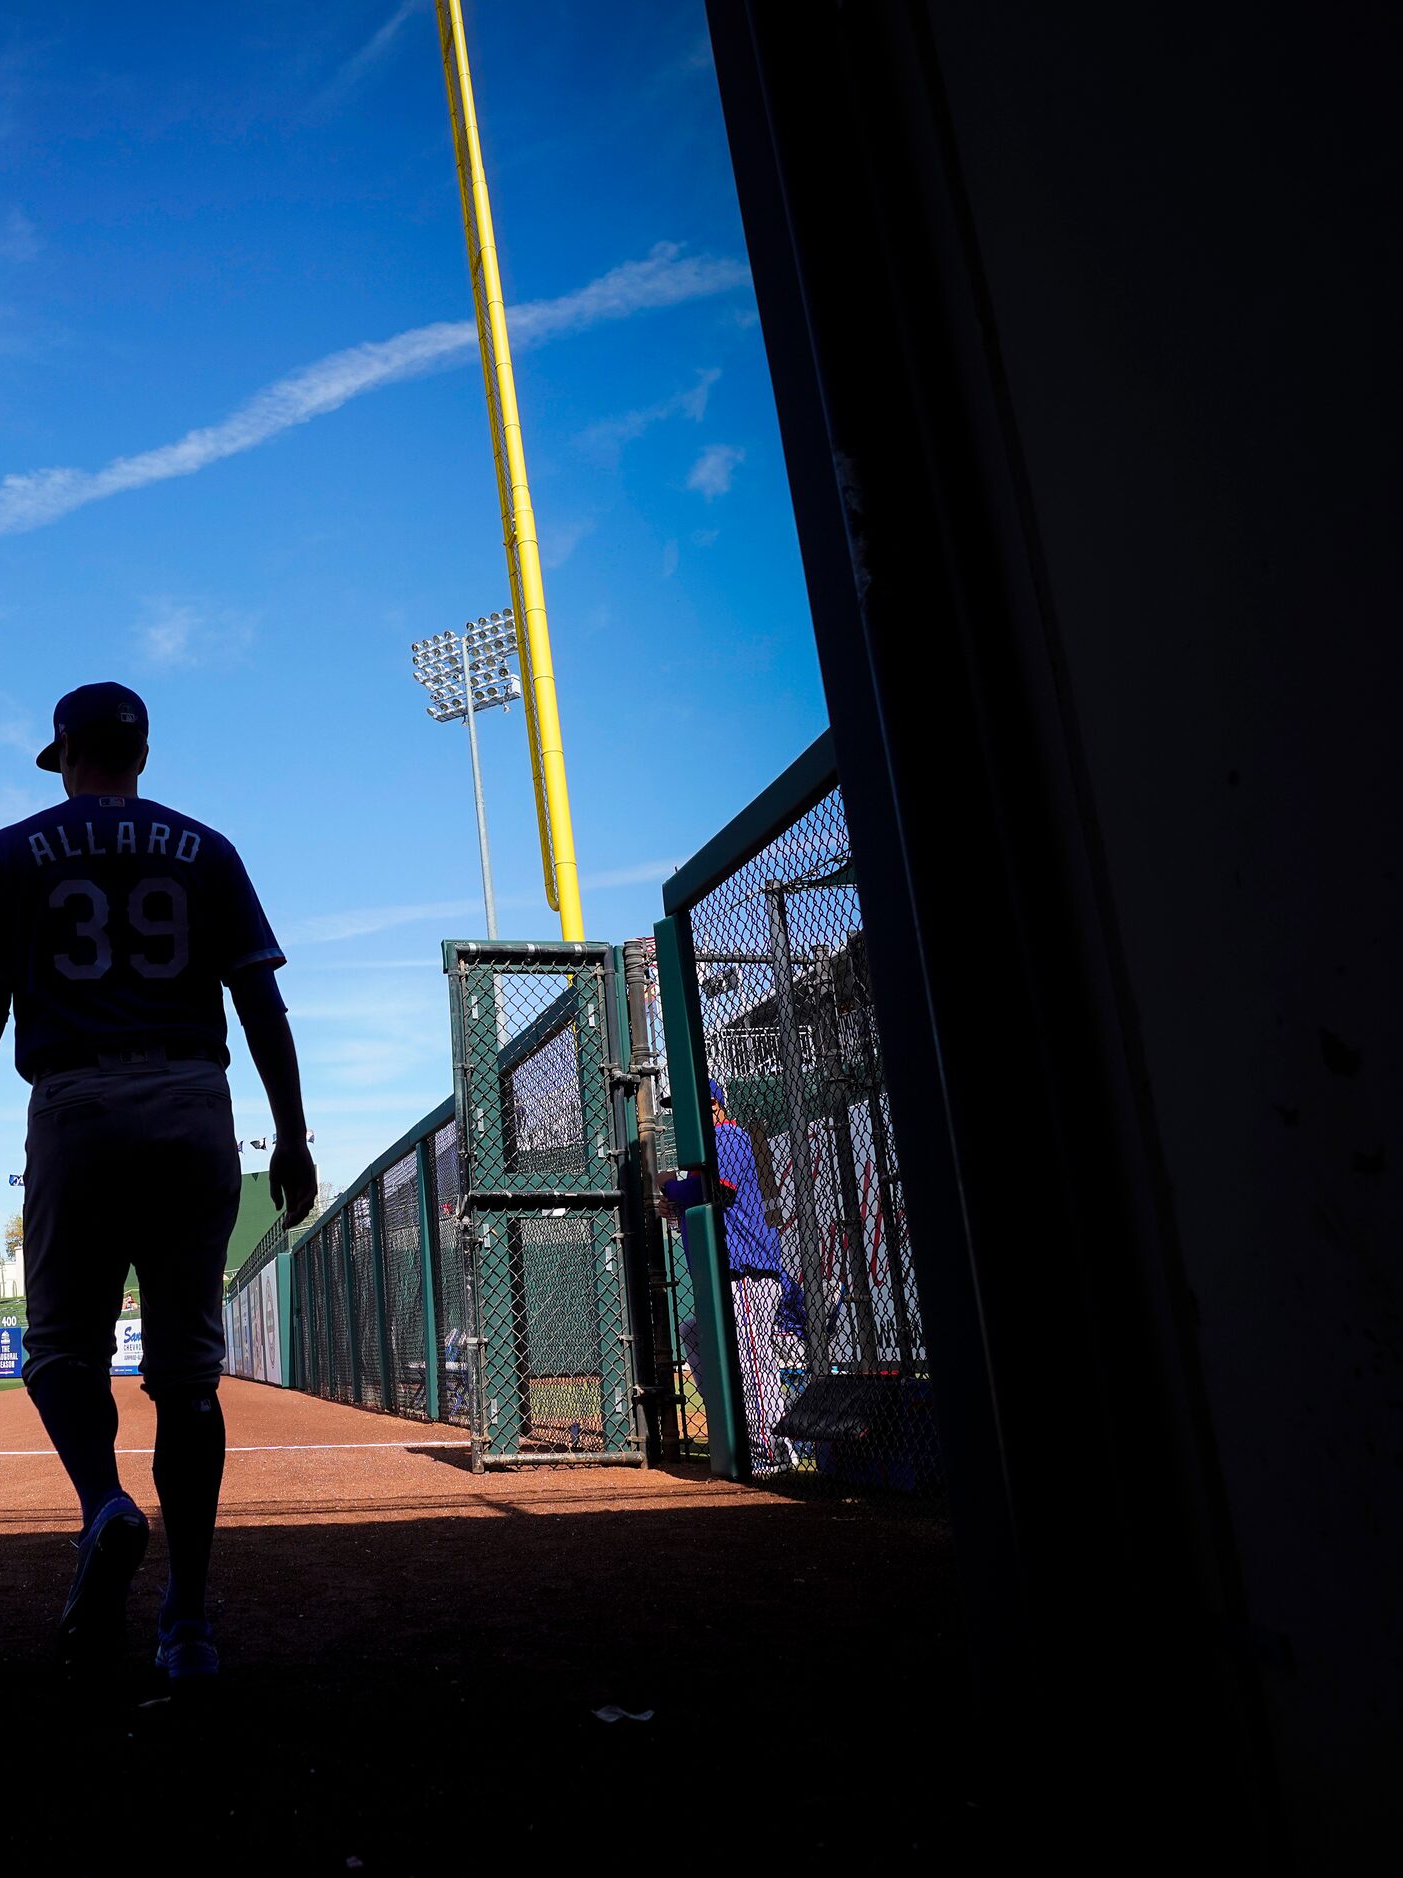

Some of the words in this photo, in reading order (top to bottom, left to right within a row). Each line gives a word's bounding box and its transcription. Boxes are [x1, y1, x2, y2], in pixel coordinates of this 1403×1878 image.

[28, 822, 201, 866] ALLARD
[49, 878, 190, 979] 39
[1, 1315, 17, 1327] 400
[1, 1345, 10, 1353] THE
